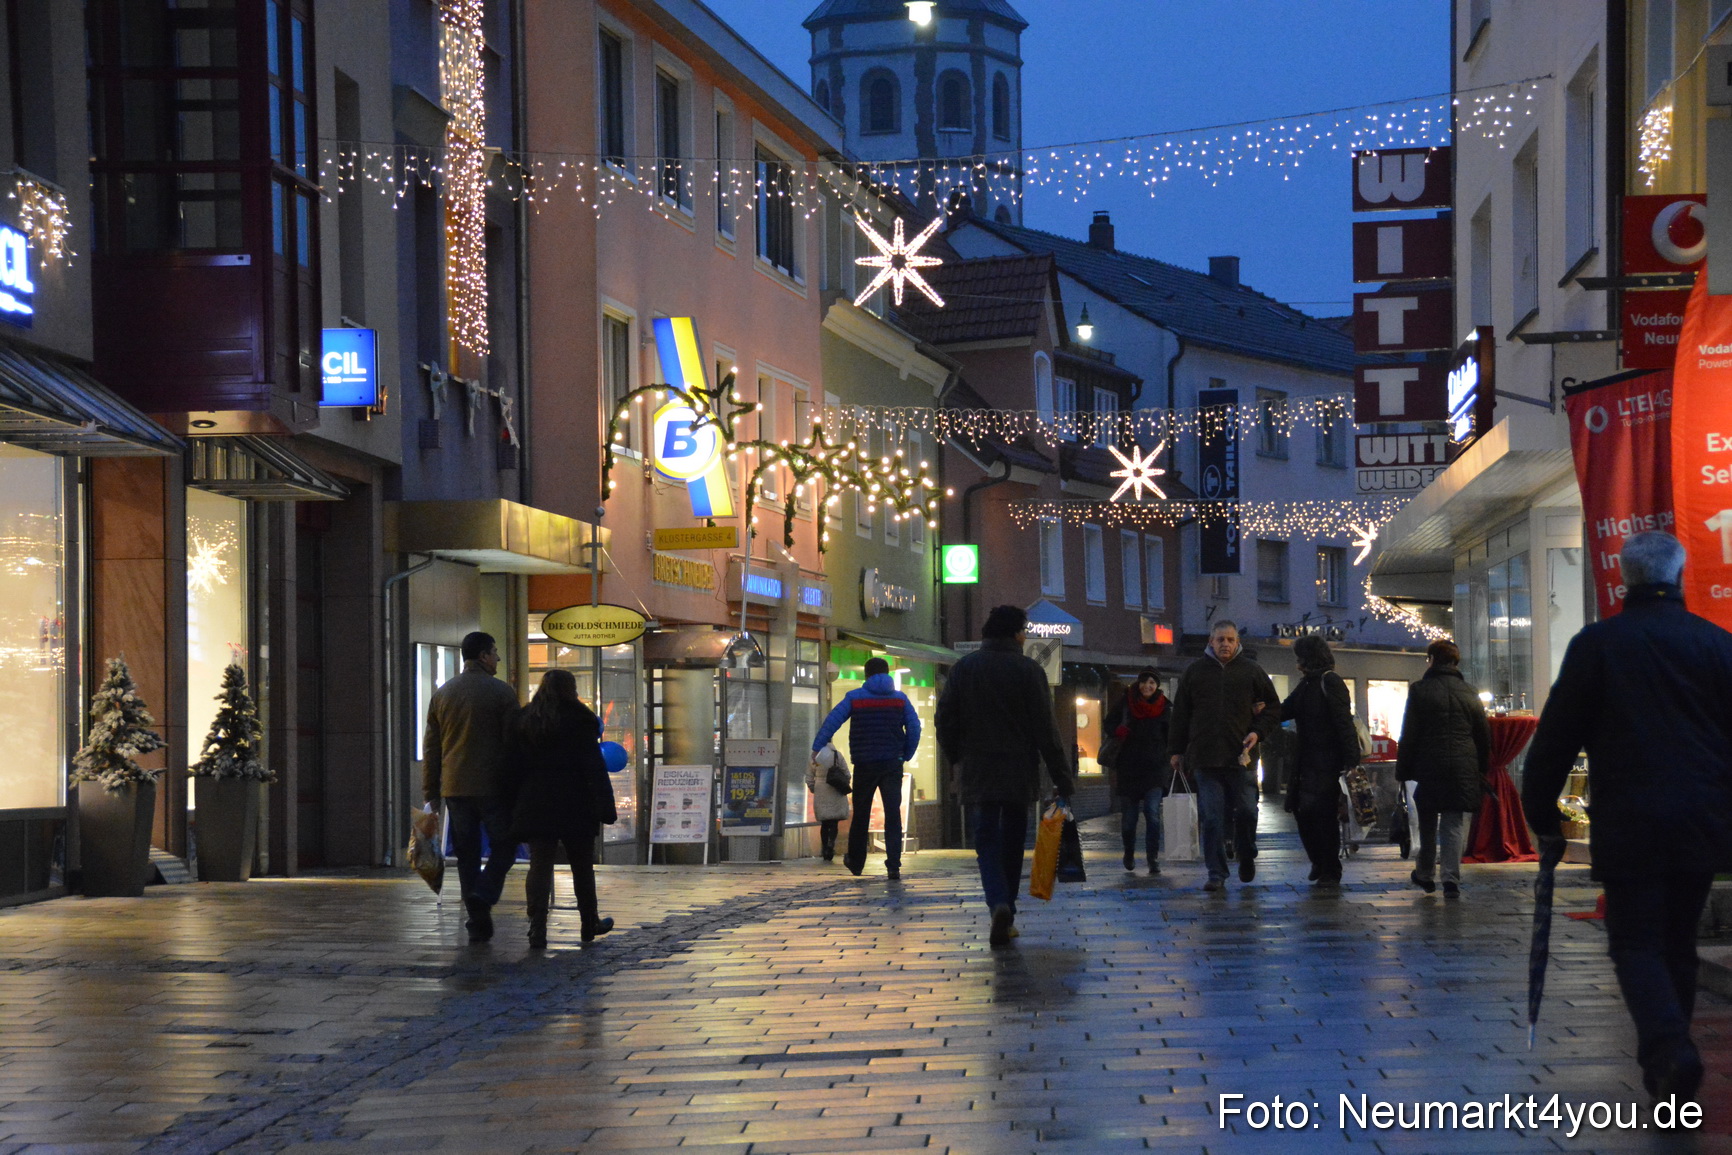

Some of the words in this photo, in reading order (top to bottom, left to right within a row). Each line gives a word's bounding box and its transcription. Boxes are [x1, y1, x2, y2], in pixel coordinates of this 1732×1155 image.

[322, 351, 367, 375] CIL
[662, 420, 698, 459] B
[1359, 435, 1448, 465] WITT
[1358, 468, 1447, 491] WEIDE
[658, 534, 723, 544] KLOSTERGASSE
[726, 533, 732, 541] 4
[548, 622, 565, 631] DIE
[566, 621, 643, 630] GOLDSCHMIEDE
